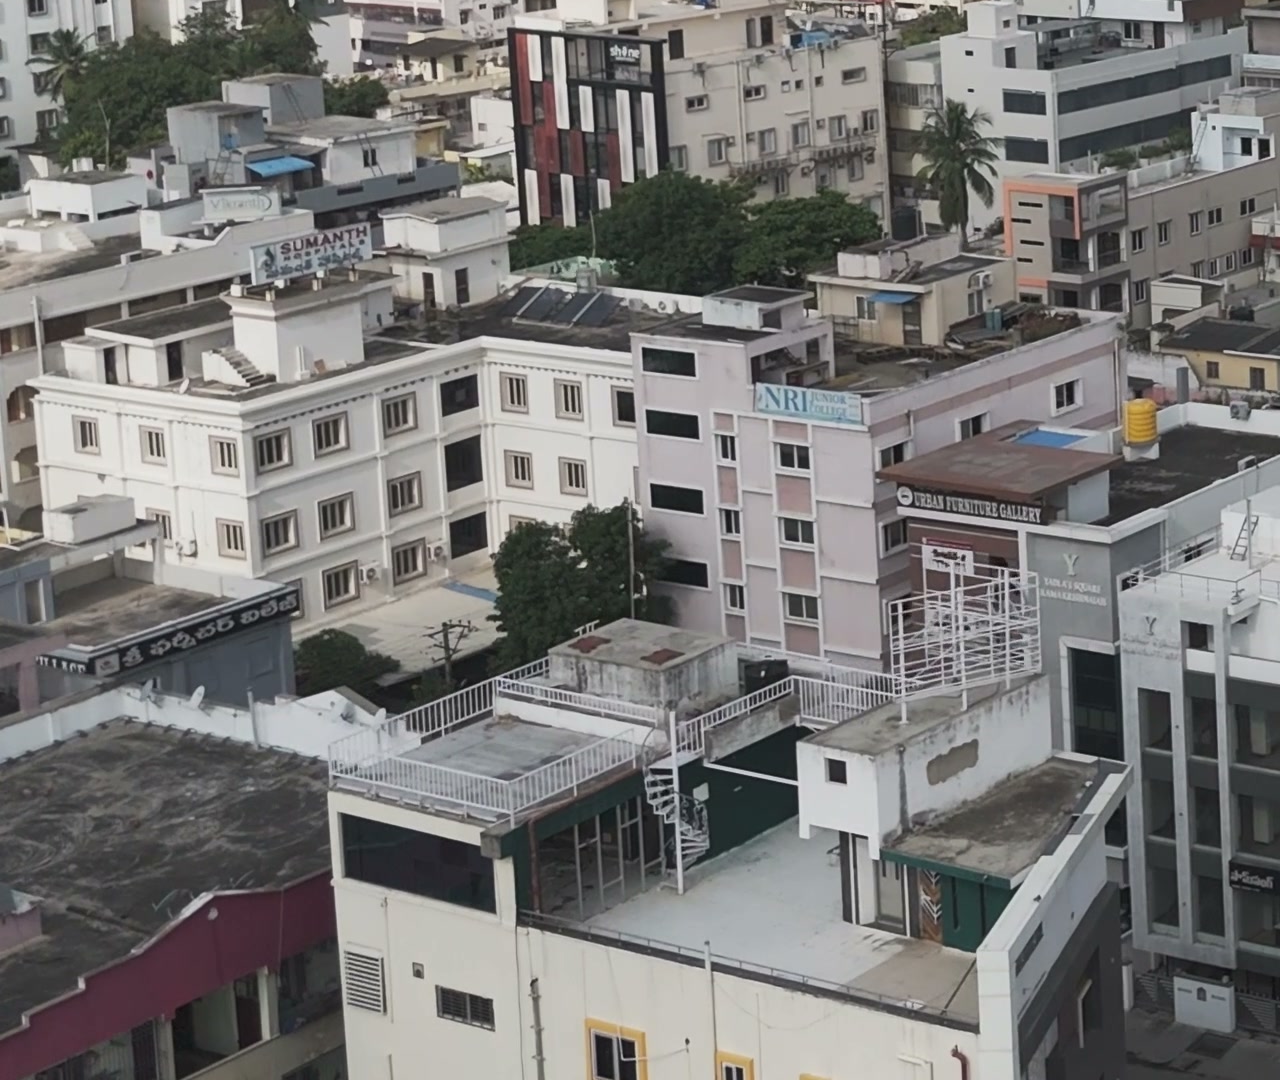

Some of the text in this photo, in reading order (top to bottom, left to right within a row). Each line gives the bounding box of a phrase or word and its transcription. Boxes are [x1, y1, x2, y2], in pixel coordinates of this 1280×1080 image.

[280, 226, 368, 256] SUMANTH
[283, 239, 366, 262] HOSPITALS
[764, 386, 808, 412] NRI
[810, 391, 847, 404] JUNIOR
[809, 405, 847, 418] COLLEGE
[914, 492, 1042, 523] URBAN FURNITURE GALLERY
[1062, 553, 1080, 576] Y
